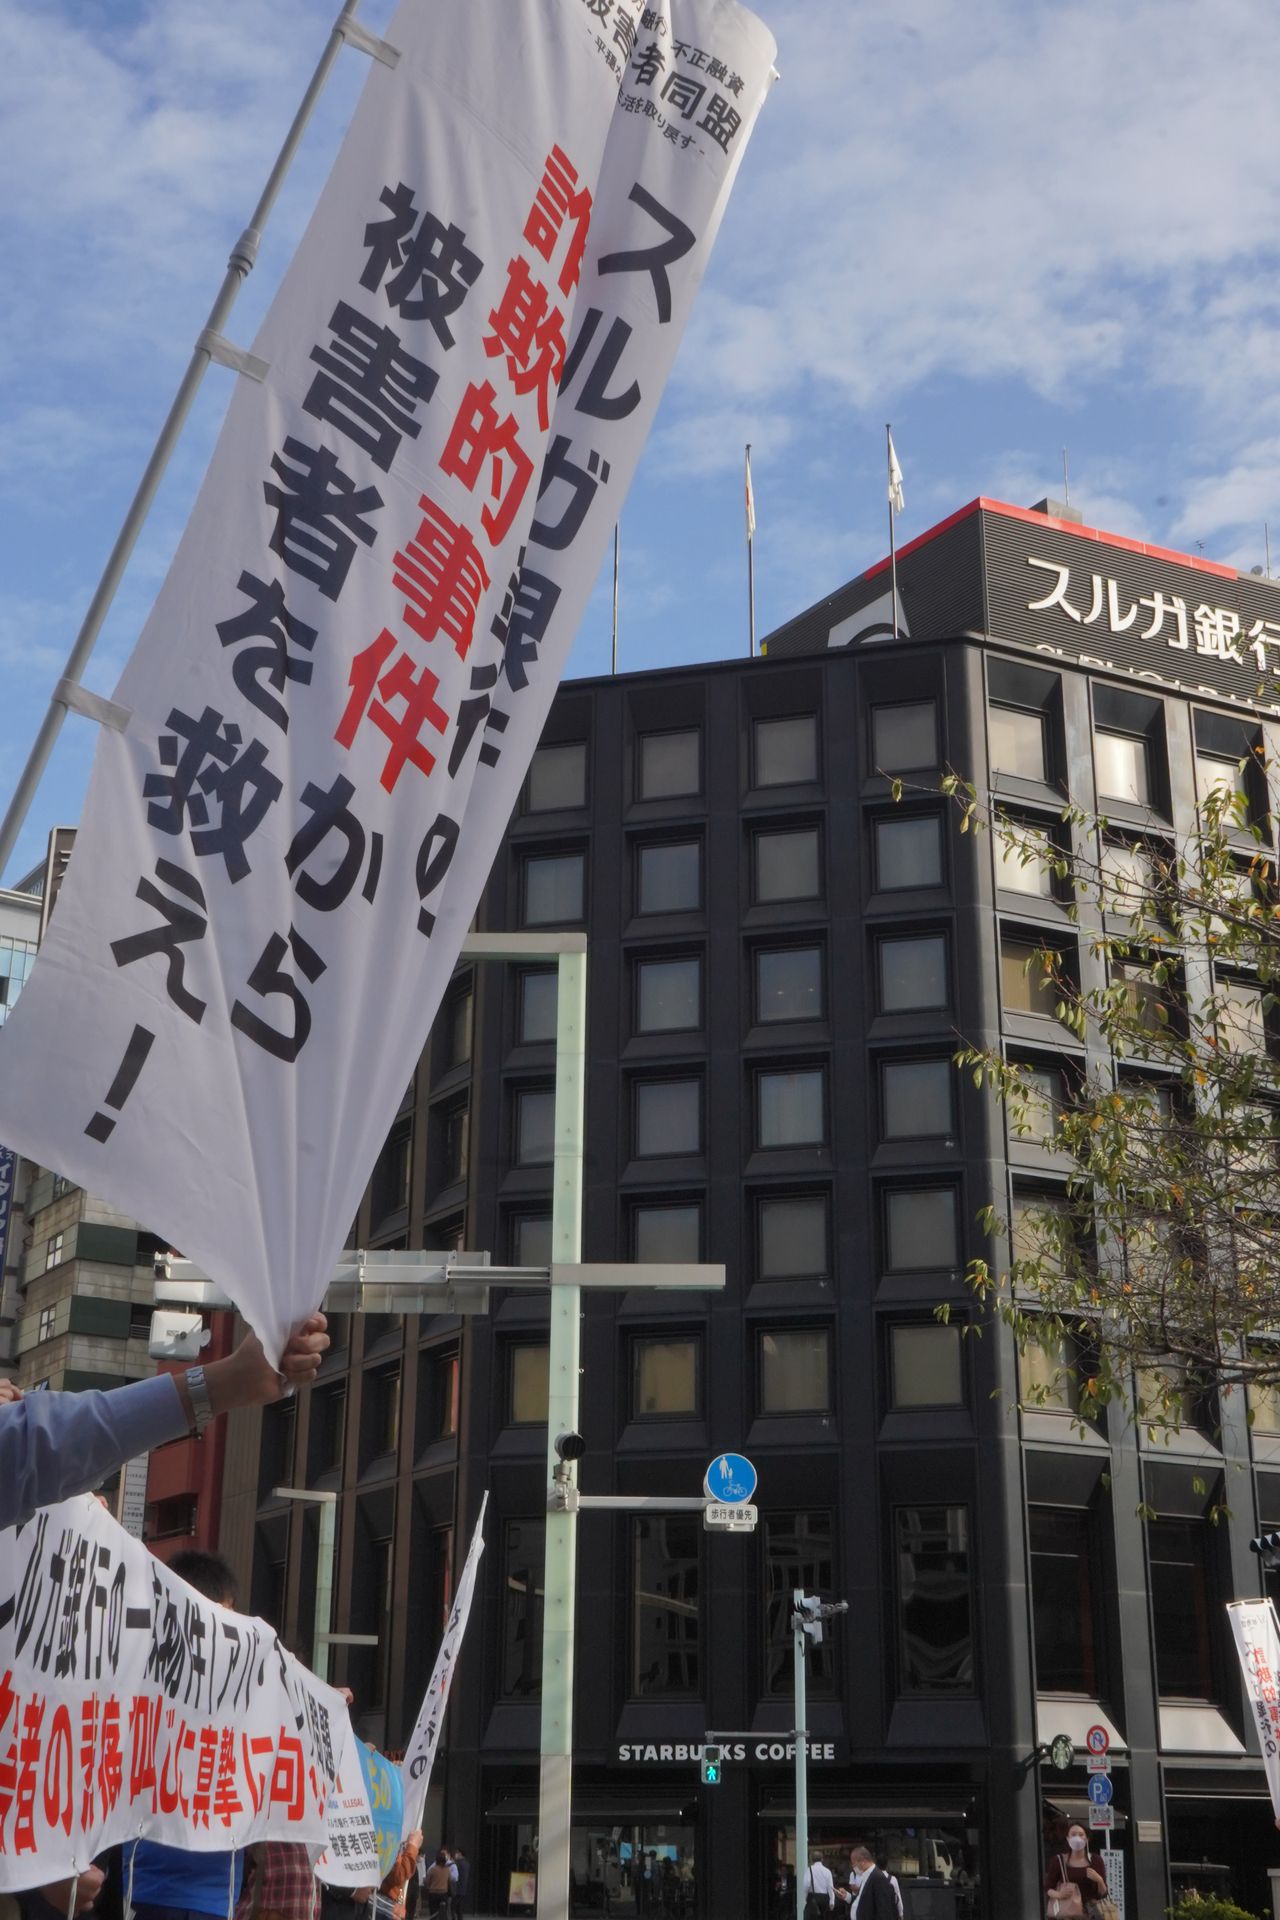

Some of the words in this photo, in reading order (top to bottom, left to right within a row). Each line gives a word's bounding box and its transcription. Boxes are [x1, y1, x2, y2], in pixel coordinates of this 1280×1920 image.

[671, 39, 745, 99] 不正融資
[1027, 556, 1280, 676] スルガ銀行
[711, 1508, 753, 1521] 歩行者優先
[618, 1744, 746, 1761] STARBUKS
[755, 1744, 835, 1760] COFEE
